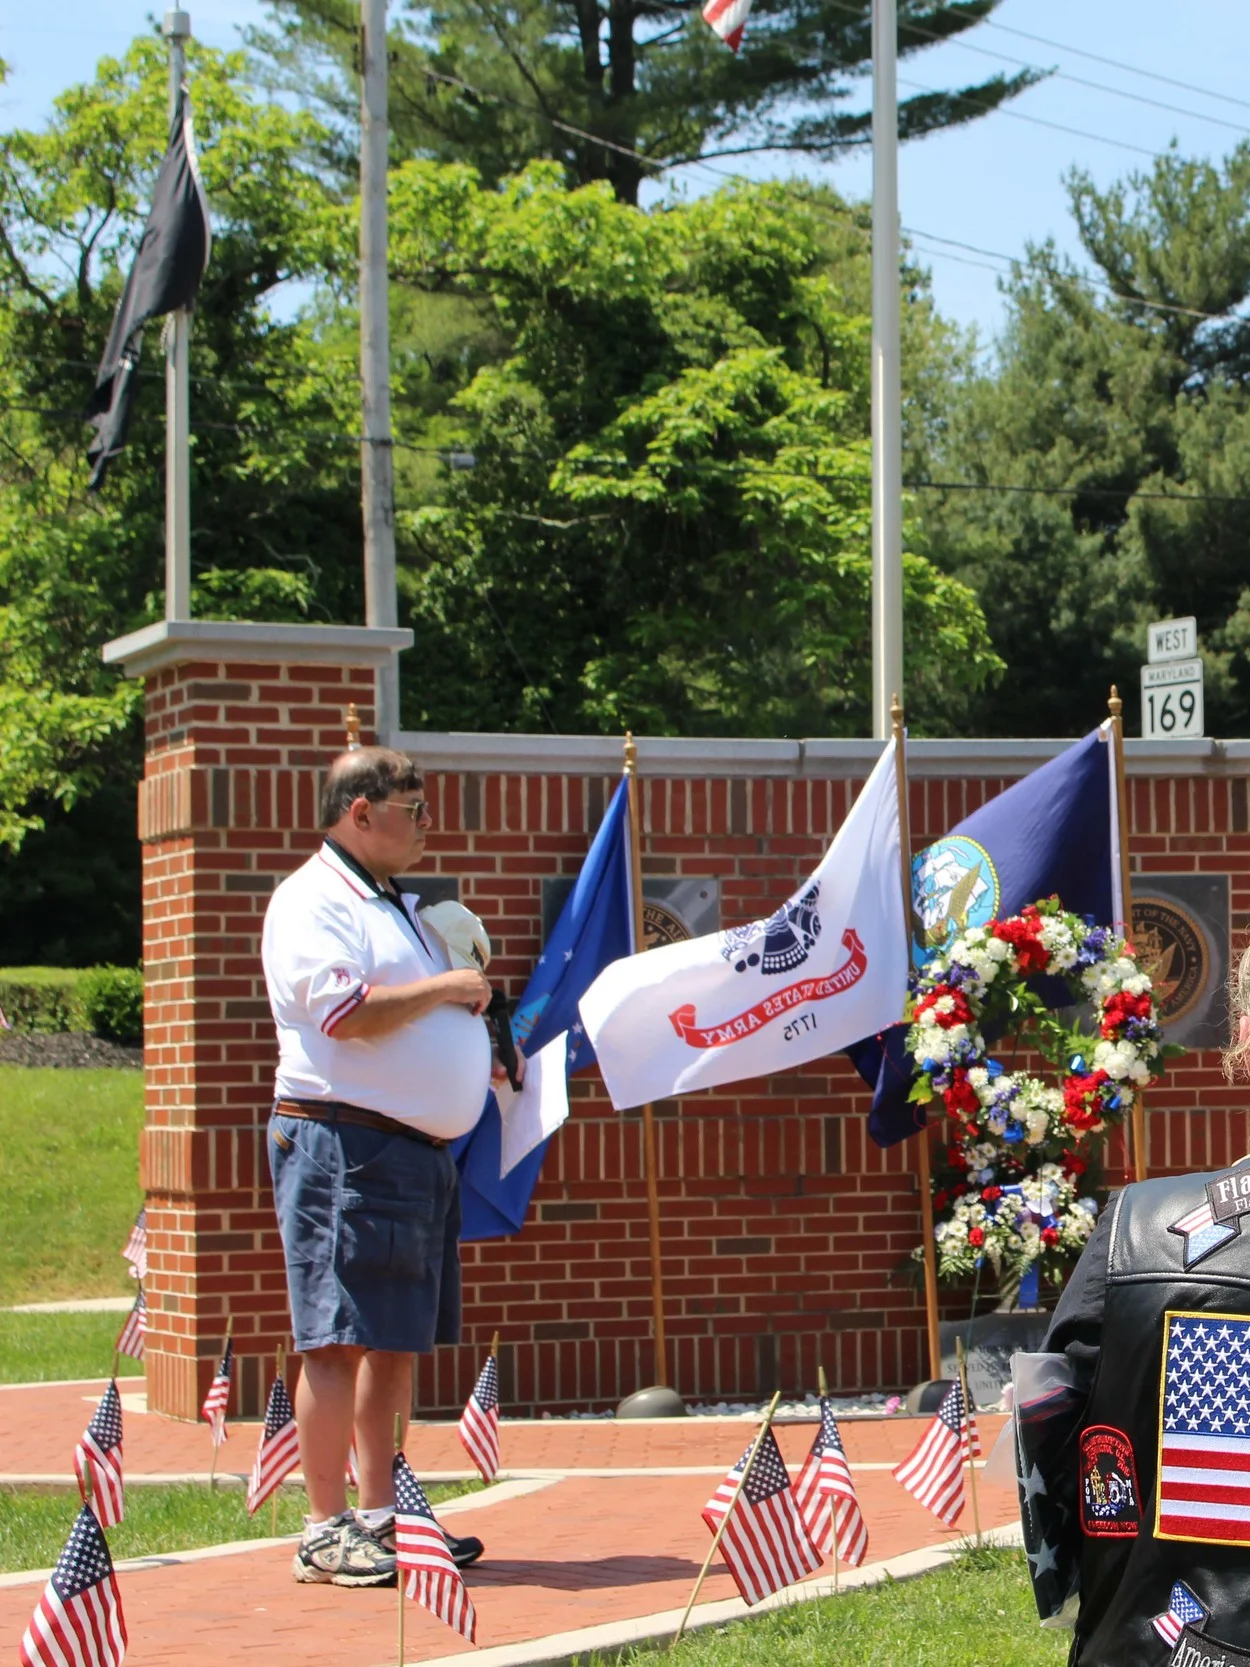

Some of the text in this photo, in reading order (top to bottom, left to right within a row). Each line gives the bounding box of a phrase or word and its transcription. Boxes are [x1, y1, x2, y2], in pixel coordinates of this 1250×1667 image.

[1155, 628, 1188, 653] WEST
[1148, 666, 1196, 682] MARYLAND
[1148, 689, 1196, 734] 169
[642, 907, 665, 922] HE
[947, 1363, 982, 1373] SEVED
